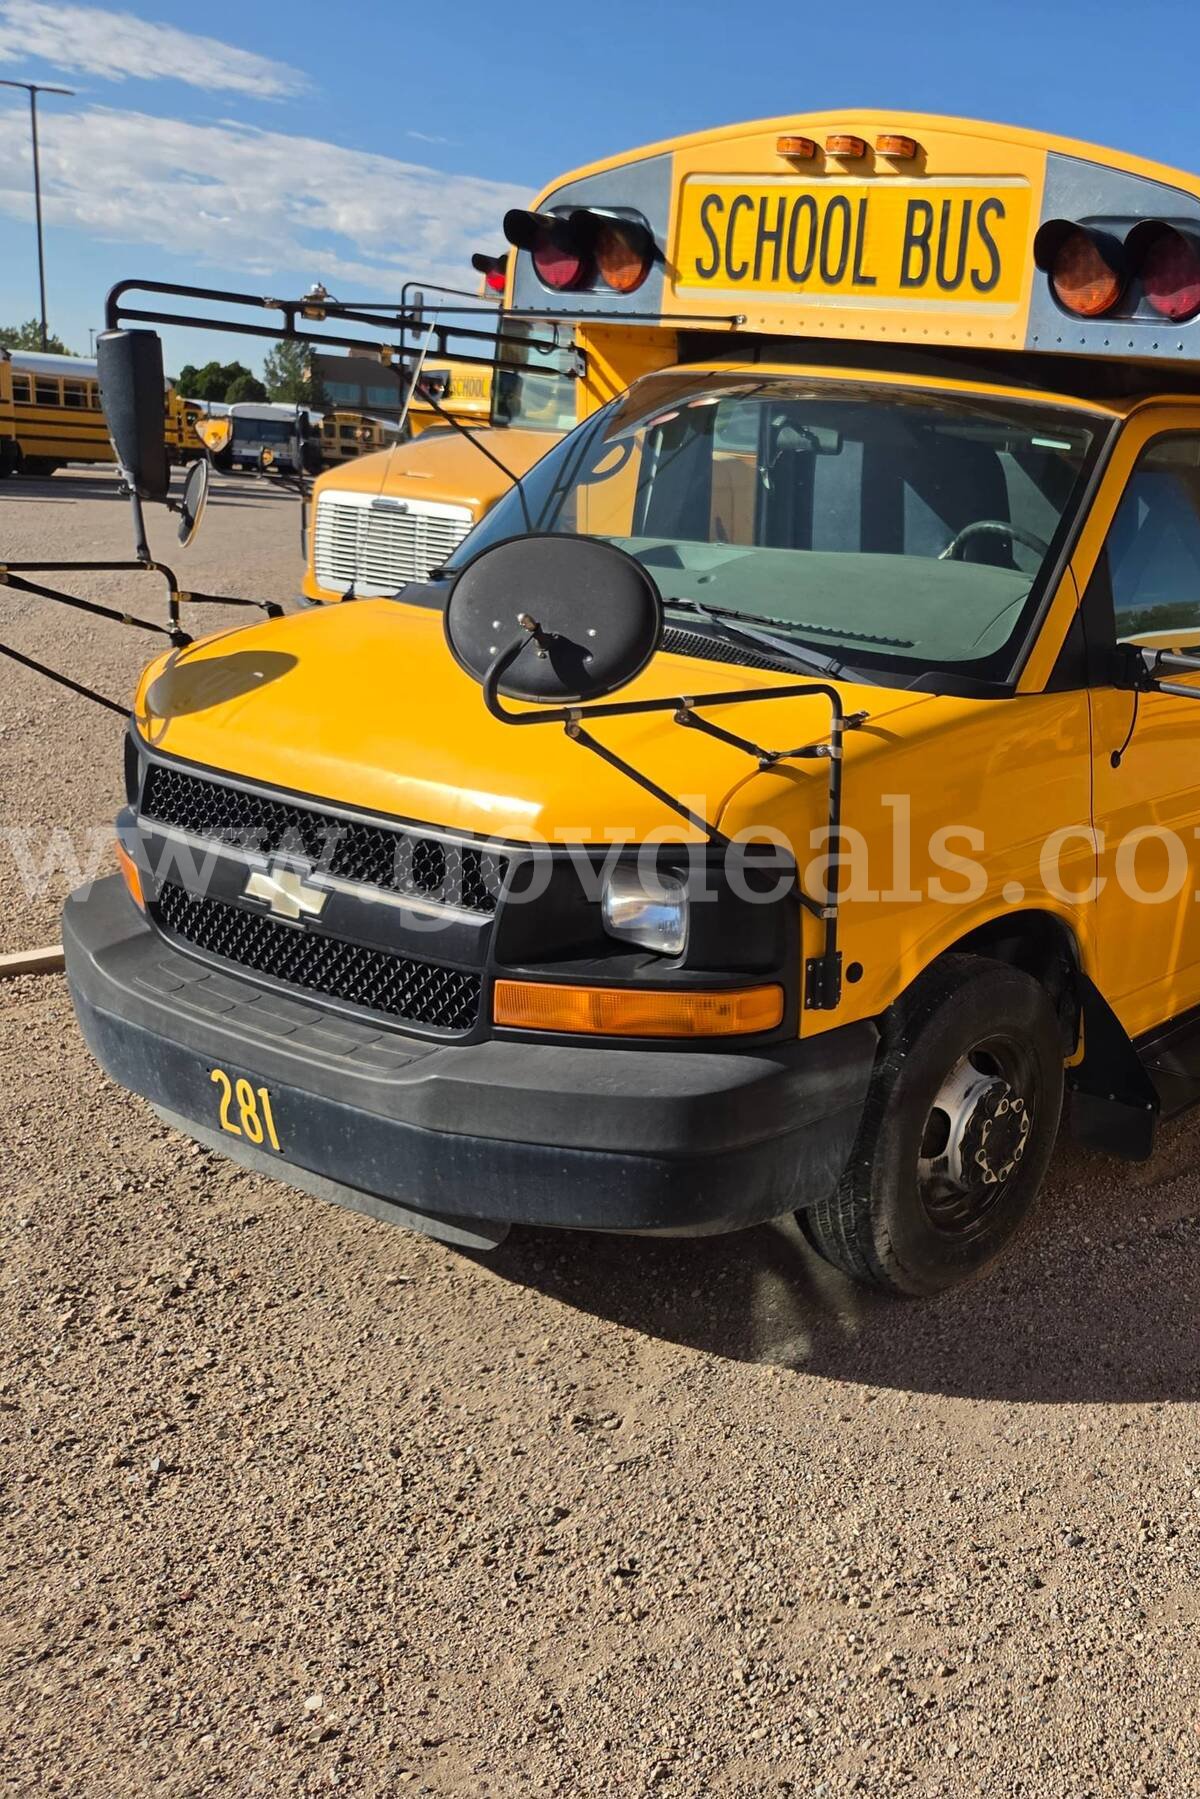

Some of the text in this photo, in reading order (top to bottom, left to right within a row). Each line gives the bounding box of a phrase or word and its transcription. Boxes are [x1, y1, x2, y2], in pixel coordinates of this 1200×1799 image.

[695, 193, 1006, 292] SCHOOL BUS
[209, 1068, 281, 1152] 281
